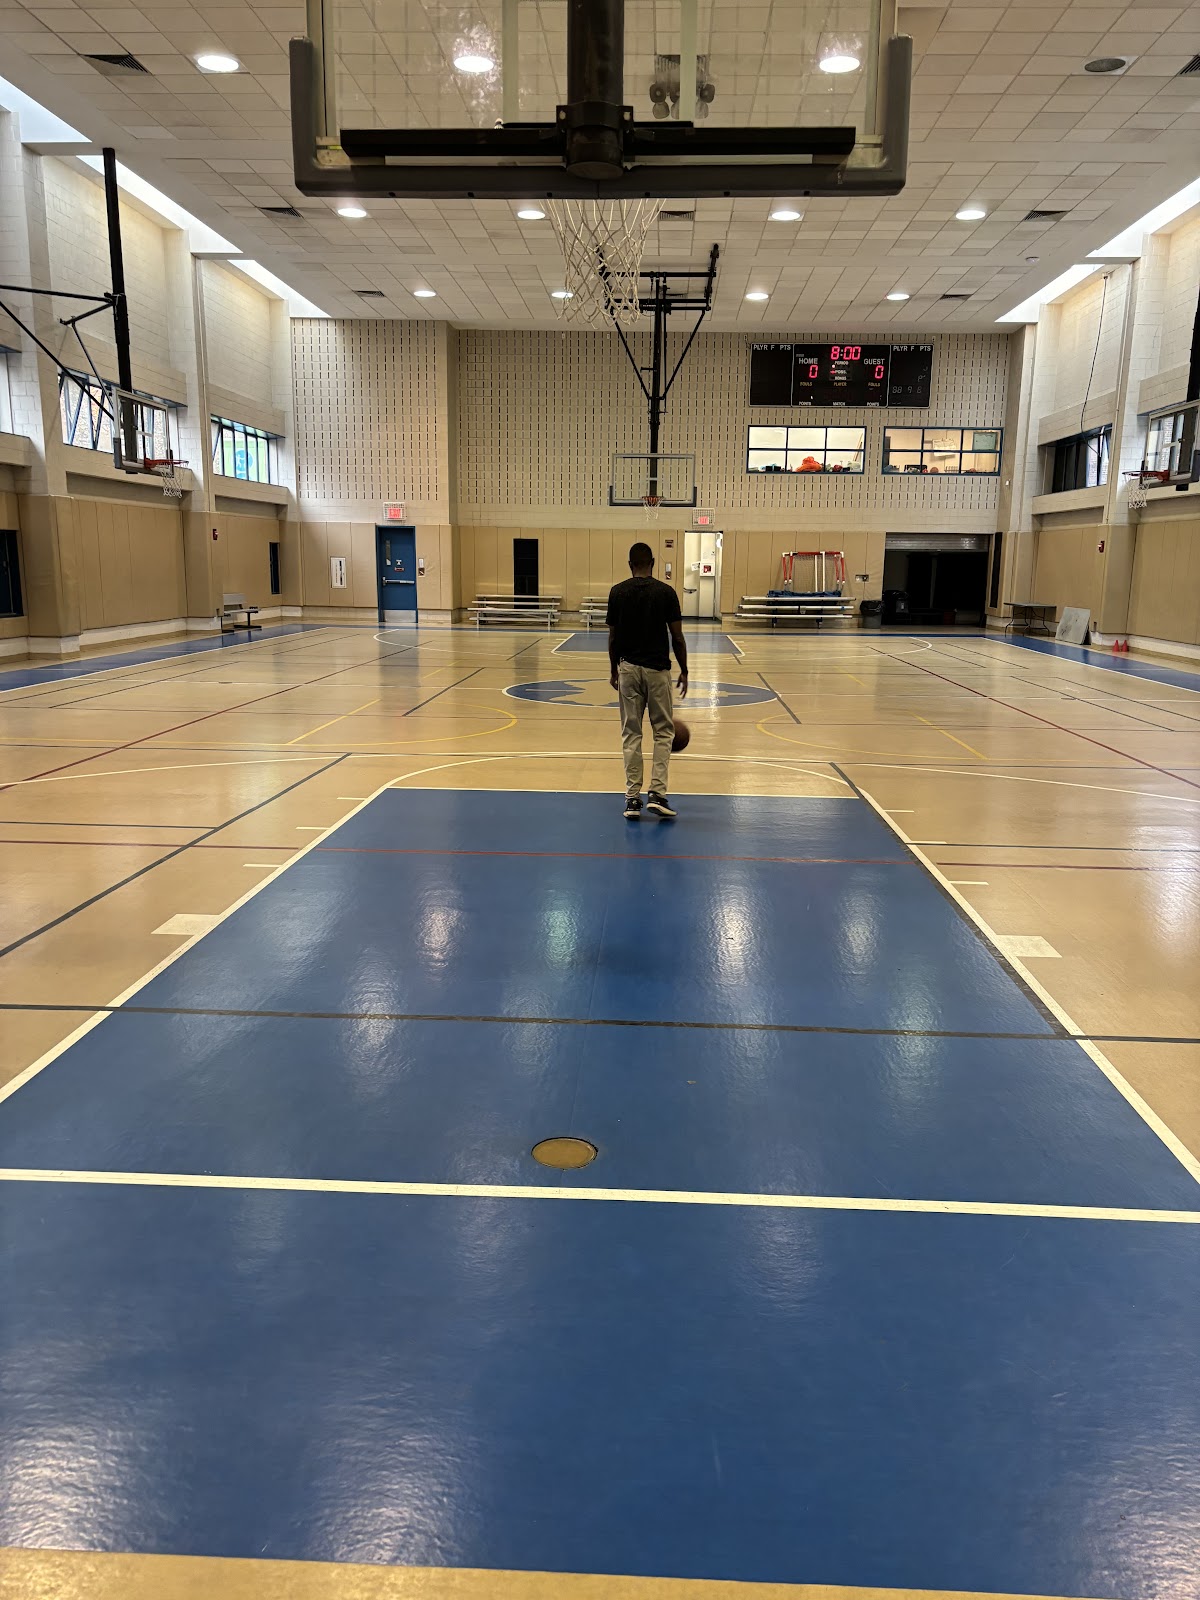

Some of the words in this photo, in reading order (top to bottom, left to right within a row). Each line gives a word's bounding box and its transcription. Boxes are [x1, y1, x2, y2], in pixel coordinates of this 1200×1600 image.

[830, 346, 861, 360] 8:00
[809, 365, 818, 378] 0
[875, 365, 884, 379] 0
